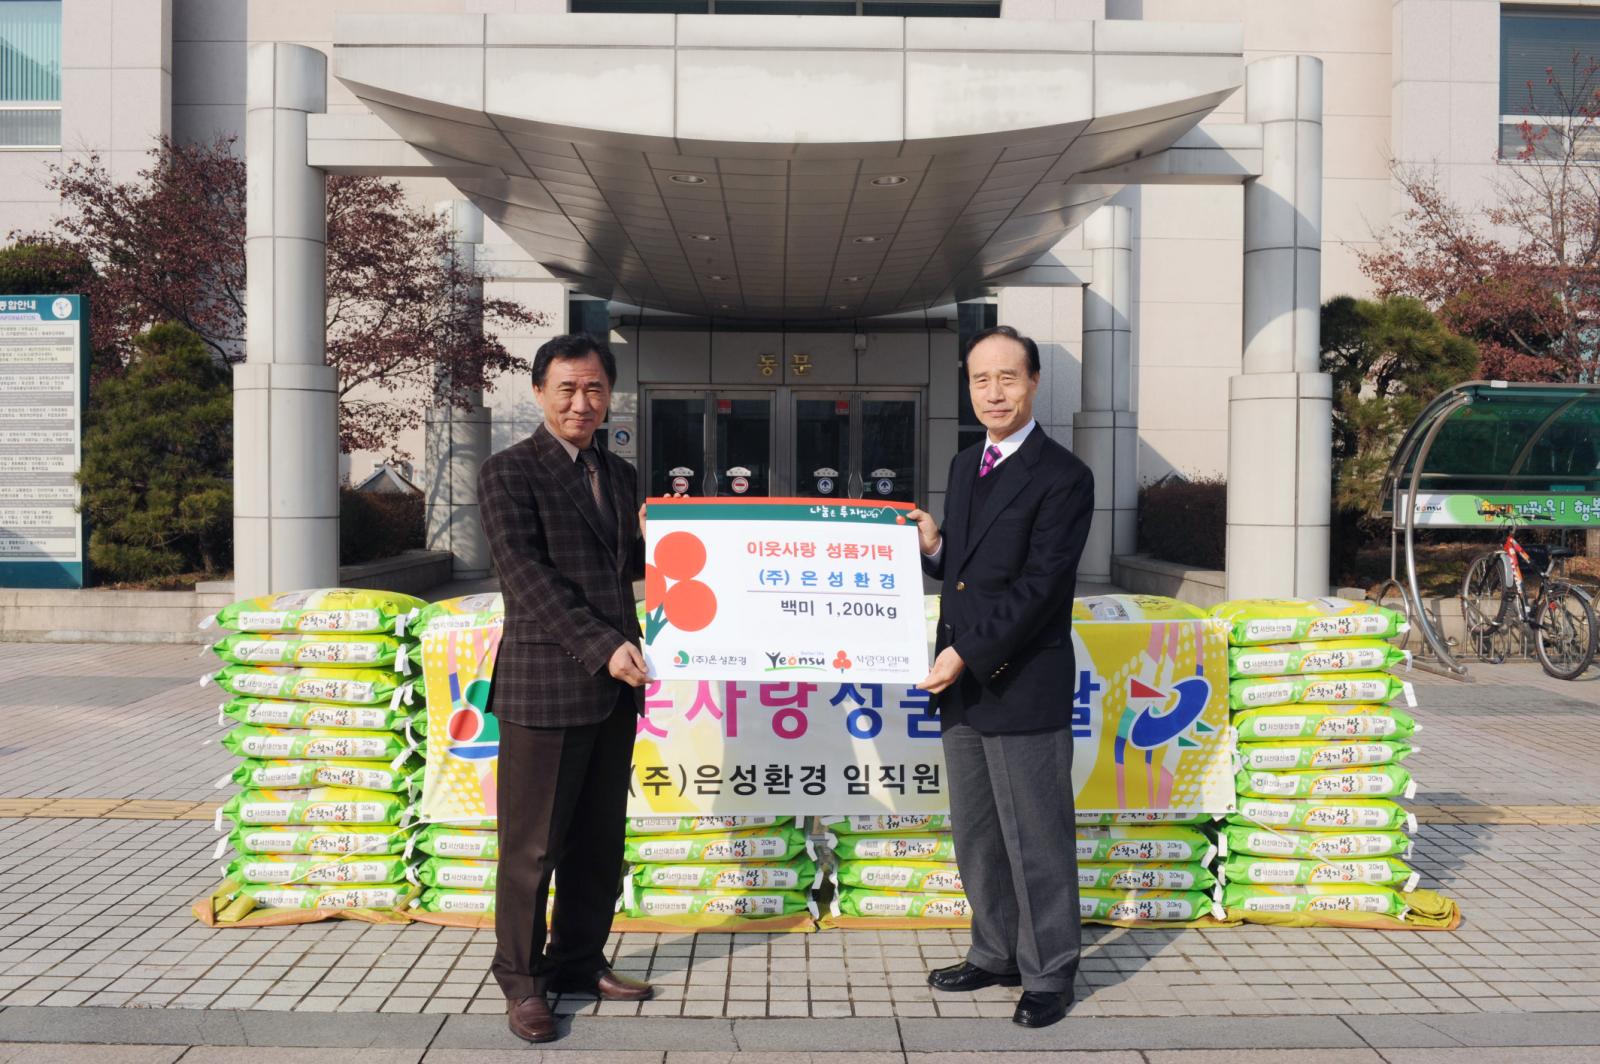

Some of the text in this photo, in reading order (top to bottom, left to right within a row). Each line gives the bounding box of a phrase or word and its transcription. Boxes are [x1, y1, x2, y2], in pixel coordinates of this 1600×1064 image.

[747, 541, 894, 561] 이웃사랑 성품기탁
[759, 569, 790, 586] (주)
[780, 600, 898, 619] 백미 1,200kg
[765, 651, 826, 670] Yeonsu
[843, 763, 942, 796] 임직원
